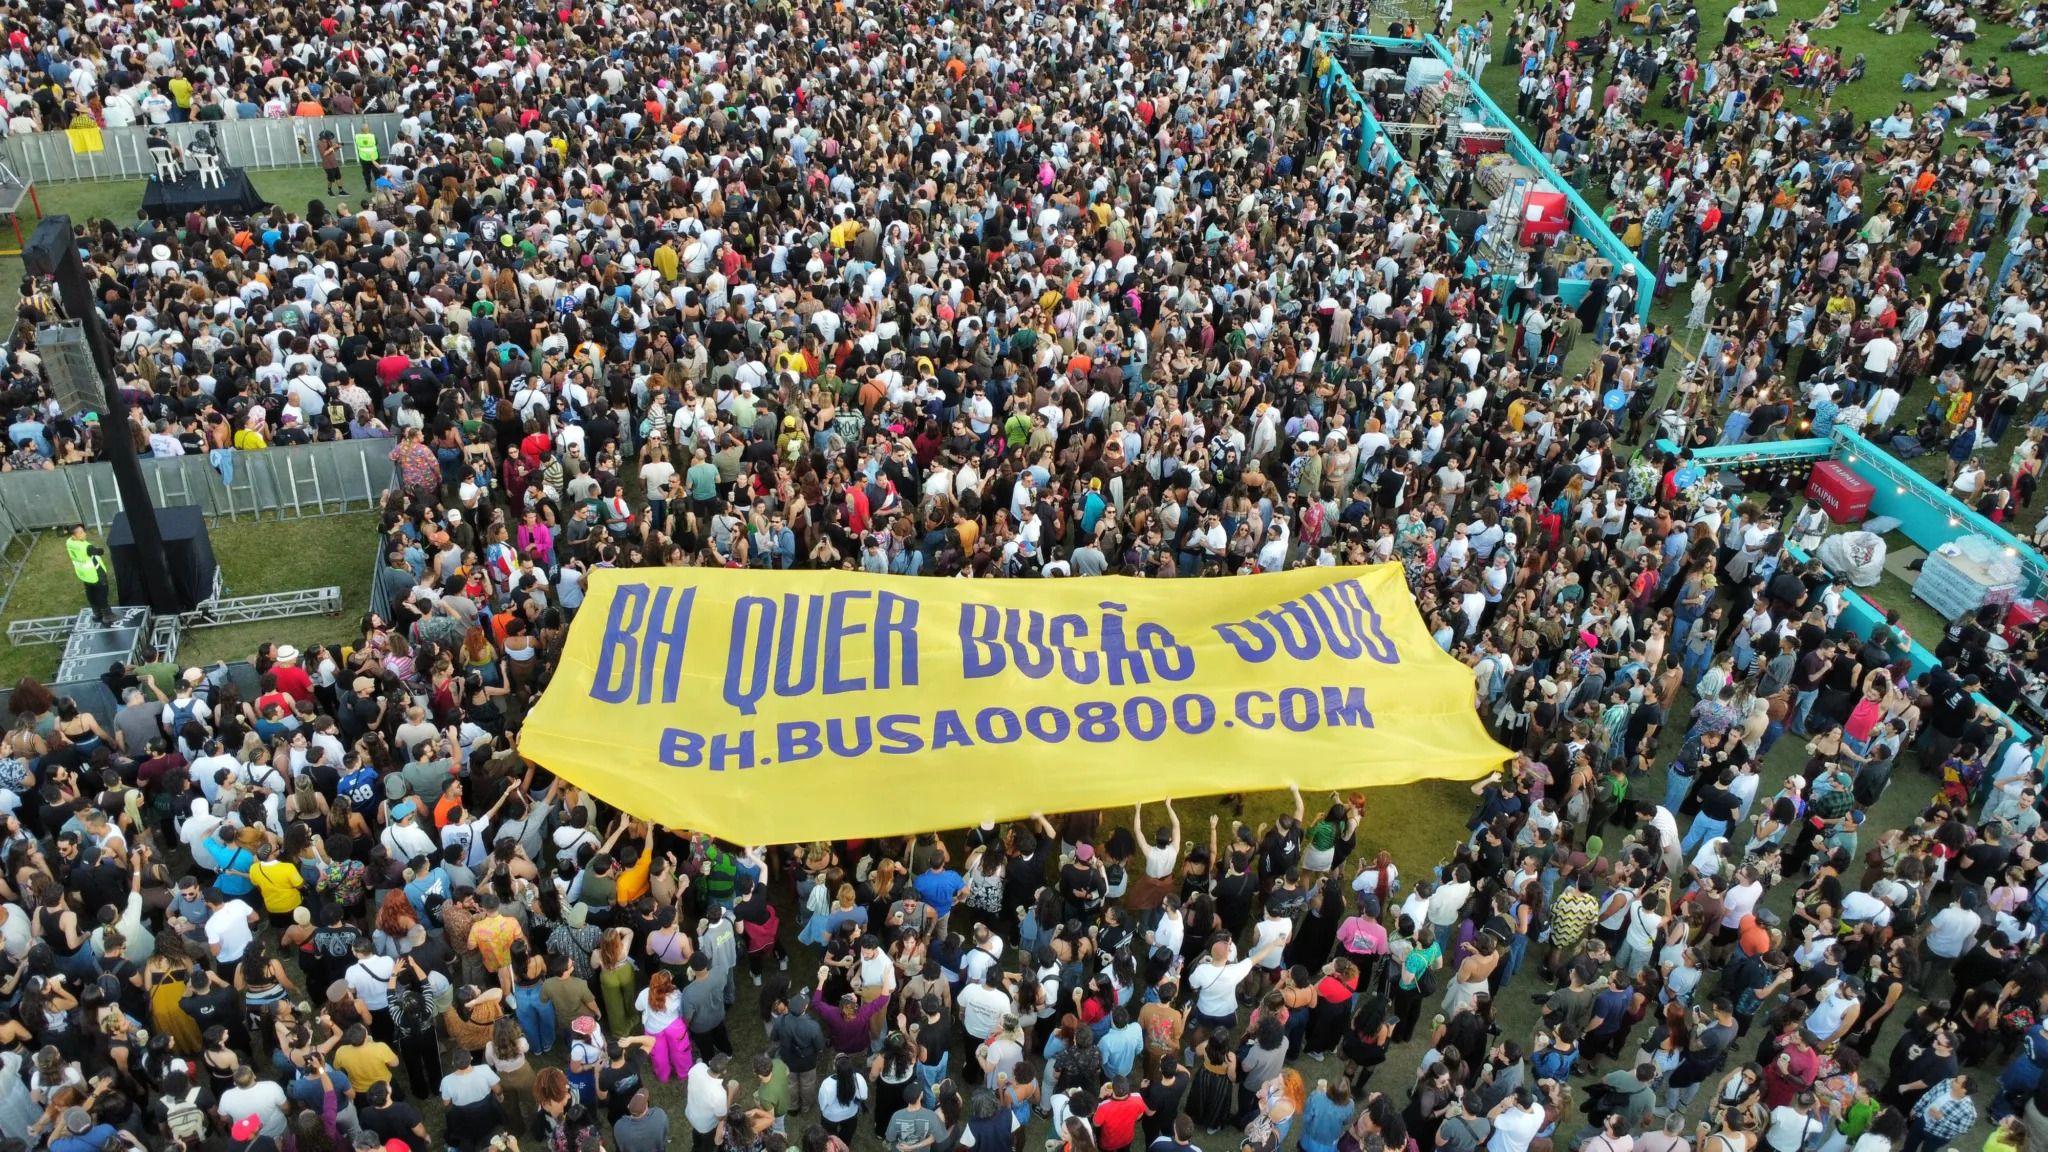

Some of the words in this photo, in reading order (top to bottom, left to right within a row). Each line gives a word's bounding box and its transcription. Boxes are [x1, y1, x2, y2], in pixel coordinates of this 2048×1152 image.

[1810, 482, 1840, 510] ITAIPAVA
[591, 584, 695, 704] BH
[724, 591, 918, 715] QUER
